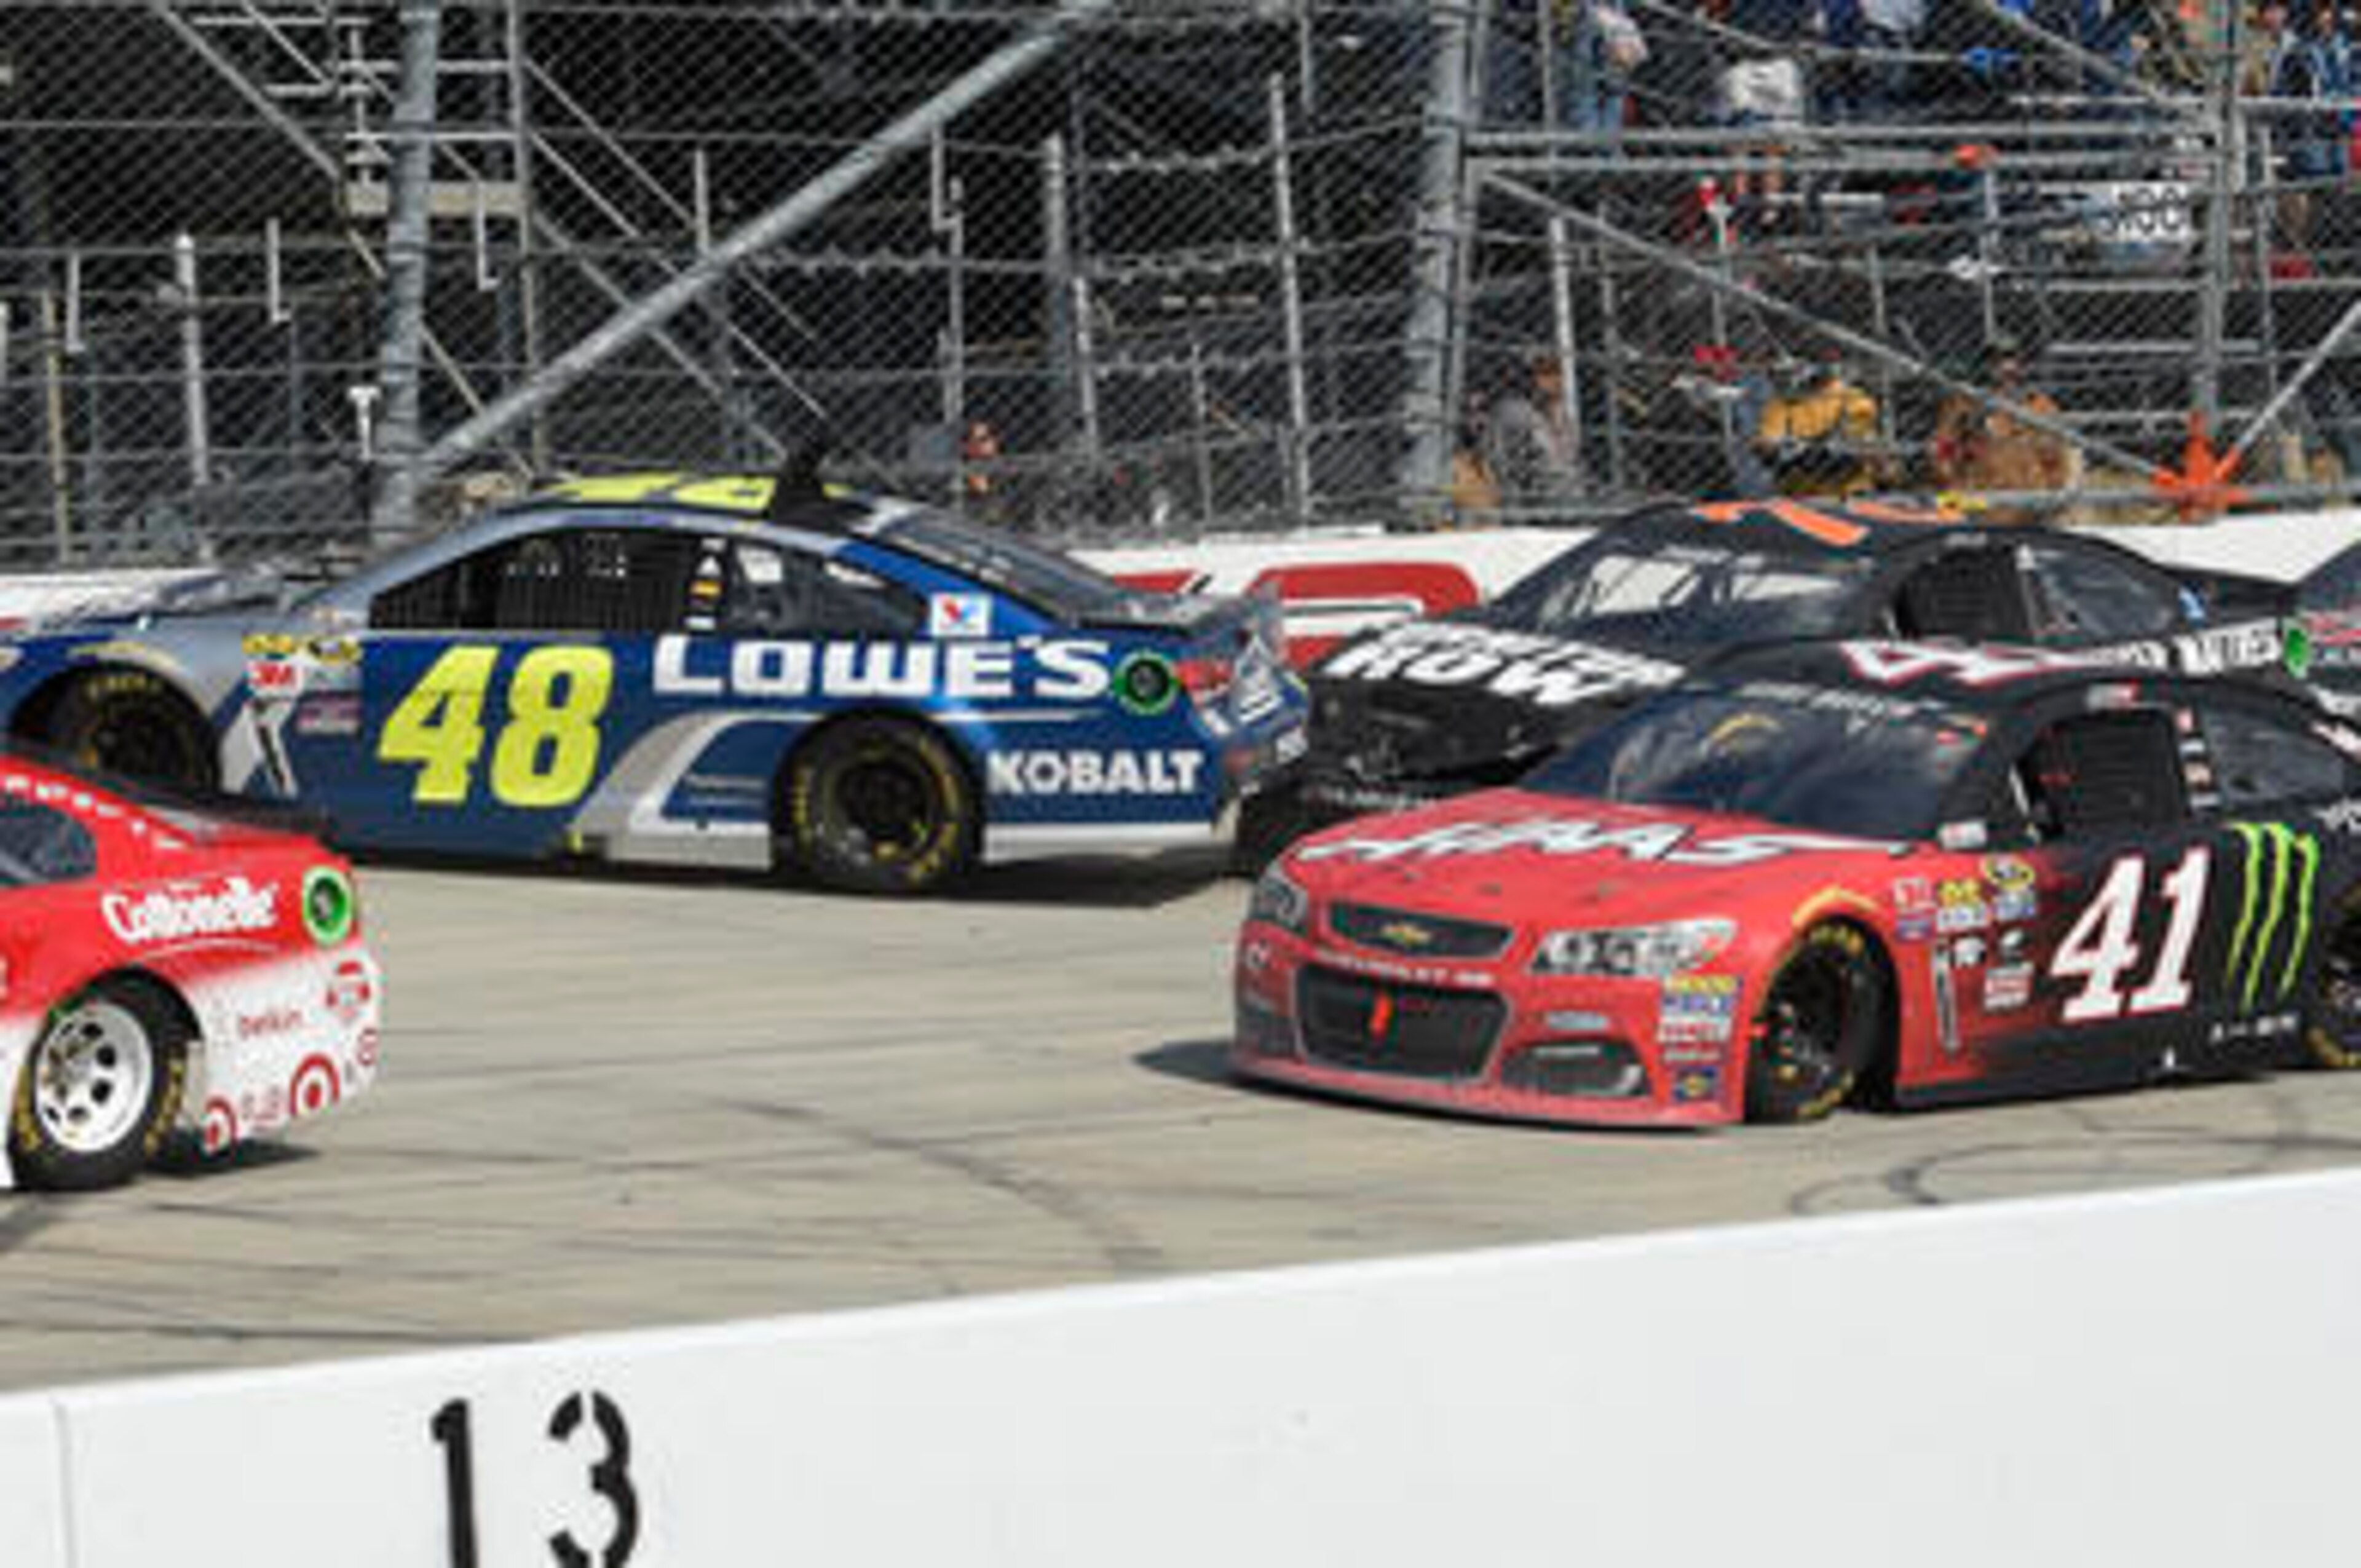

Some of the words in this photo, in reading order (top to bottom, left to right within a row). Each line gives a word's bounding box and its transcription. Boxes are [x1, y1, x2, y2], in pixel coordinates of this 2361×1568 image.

[653, 633, 1110, 699] LOWE'S
[376, 643, 614, 808] 48
[988, 748, 1205, 795] KOBALT
[2049, 845, 2211, 1022] 41
